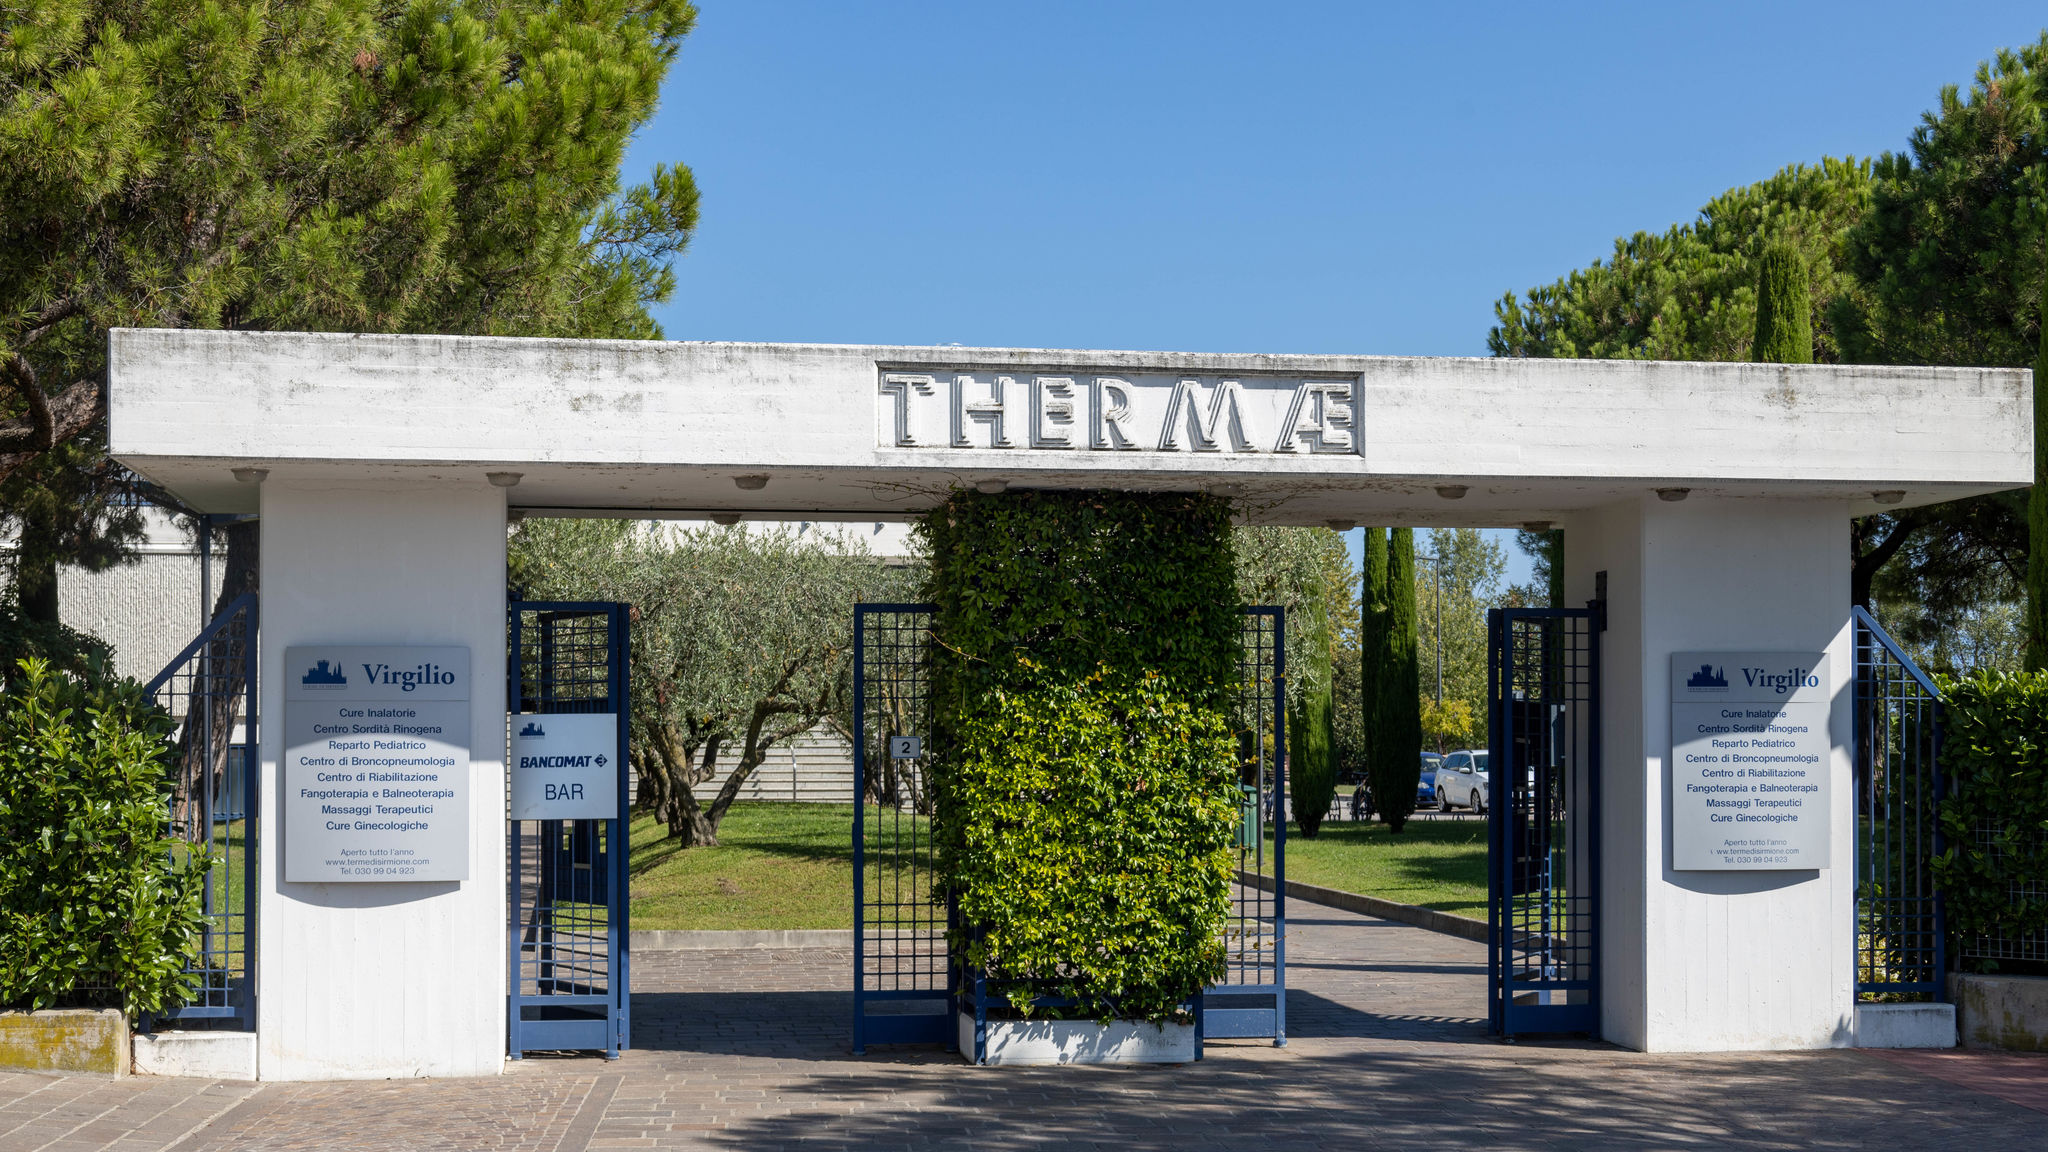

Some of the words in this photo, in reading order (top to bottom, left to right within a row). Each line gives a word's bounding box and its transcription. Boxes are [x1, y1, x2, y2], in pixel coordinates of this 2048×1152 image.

[362, 663, 455, 691] Virgilio
[1741, 668, 1819, 693] Virgilio
[339, 708, 364, 718] Cure
[367, 708, 416, 718] Inalatorie
[1721, 709, 1742, 718] Cure
[1746, 709, 1786, 718] Inalatorie
[313, 724, 349, 734] Centro
[352, 724, 390, 734] Sordità
[393, 724, 442, 736] Rinogena
[1698, 724, 1729, 733] Centro
[1733, 724, 1765, 733] Sordità
[1768, 724, 1808, 734] Rinogena
[329, 740, 370, 752] Reparto
[373, 740, 426, 750] Pediatrico
[901, 741, 911, 754] 2
[1712, 739, 1749, 749] Reparto
[1751, 739, 1795, 748] Pediatrico
[300, 757, 335, 766] Centro
[339, 756, 348, 766] di
[352, 756, 455, 768] Broncopneumologia
[520, 755, 592, 768] BANCOMAT
[1686, 754, 1718, 763] Centro
[1721, 754, 1730, 763] di
[1733, 754, 1819, 765] Broncopneumologia
[317, 772, 352, 782] Centro
[356, 772, 365, 782] di
[369, 772, 438, 782] Riabilitazione
[1702, 769, 1734, 778] Centro
[1737, 769, 1745, 778] di
[1748, 769, 1806, 777] Riabilitazione
[301, 788, 369, 800] Fangoterapia
[372, 790, 379, 798] e
[382, 788, 454, 800] Balneoterapia
[545, 783, 584, 800] BAR
[1687, 784, 1748, 794] Fangoterapia
[1760, 783, 1818, 793] Balneoterapia
[1706, 799, 1751, 809] Massaggi
[1754, 798, 1802, 808] Terapeutici
[321, 805, 372, 817] Massaggi
[375, 805, 433, 816] Terapeutici
[1710, 814, 1733, 823] Cure
[1736, 813, 1798, 824] Ginecologiche
[326, 821, 350, 831] Cure
[354, 821, 428, 832] Ginecologiche
[341, 849, 366, 858] Aperto
[325, 857, 430, 866] www.termedisirmione.com
[340, 867, 352, 875] Tel.
[354, 867, 371, 875] 030
[375, 867, 385, 875] 99
[387, 867, 397, 875] 04
[399, 867, 415, 875] 923
